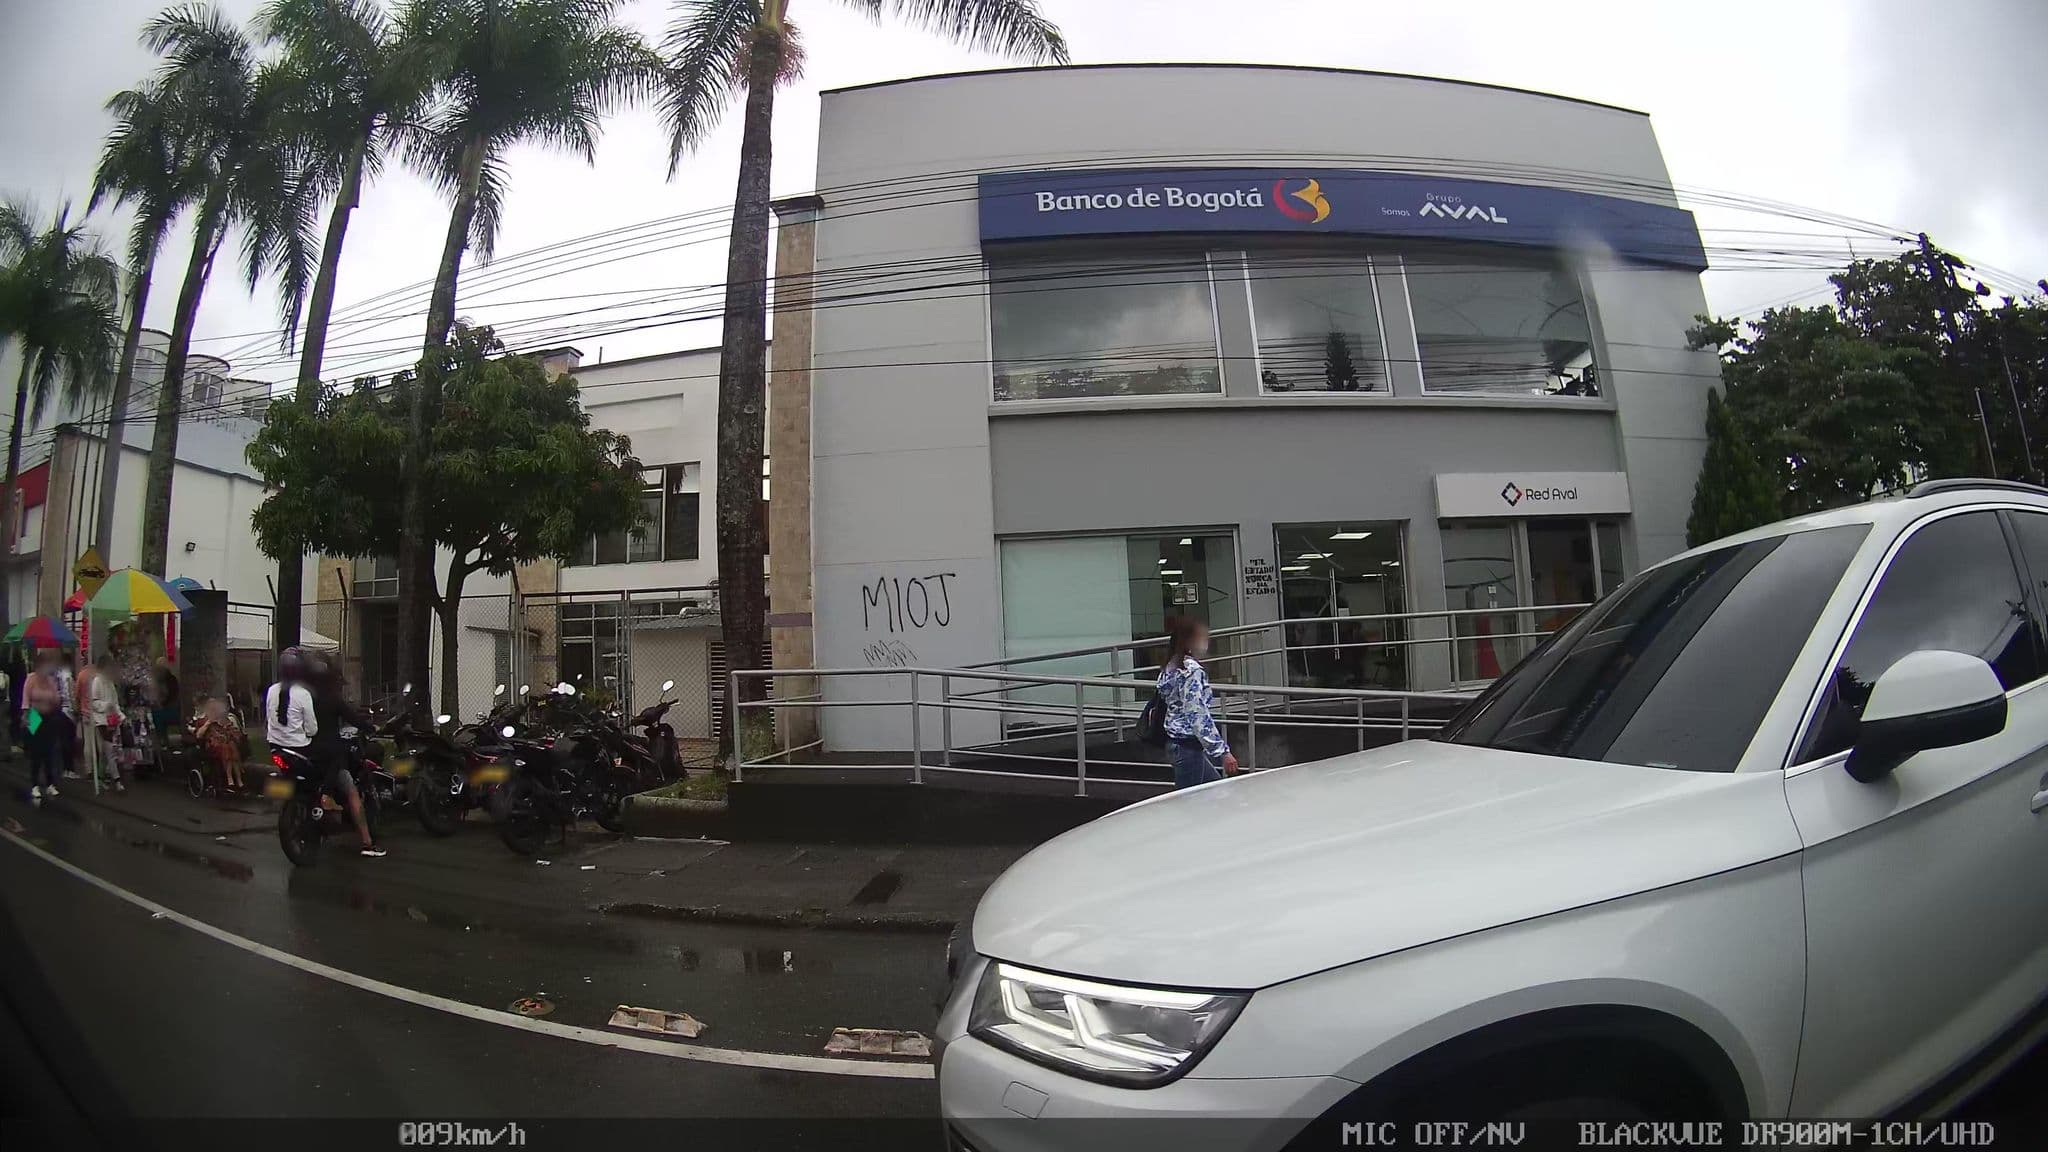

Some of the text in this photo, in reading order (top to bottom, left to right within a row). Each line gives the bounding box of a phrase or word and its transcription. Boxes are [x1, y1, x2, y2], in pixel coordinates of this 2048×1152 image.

[1035, 187, 1264, 212] Banco de Bogotá
[1426, 192, 1462, 203] Grupo
[1381, 207, 1411, 217] Somos
[1419, 201, 1508, 224] AVAL
[1525, 487, 1578, 501] Red Aval
